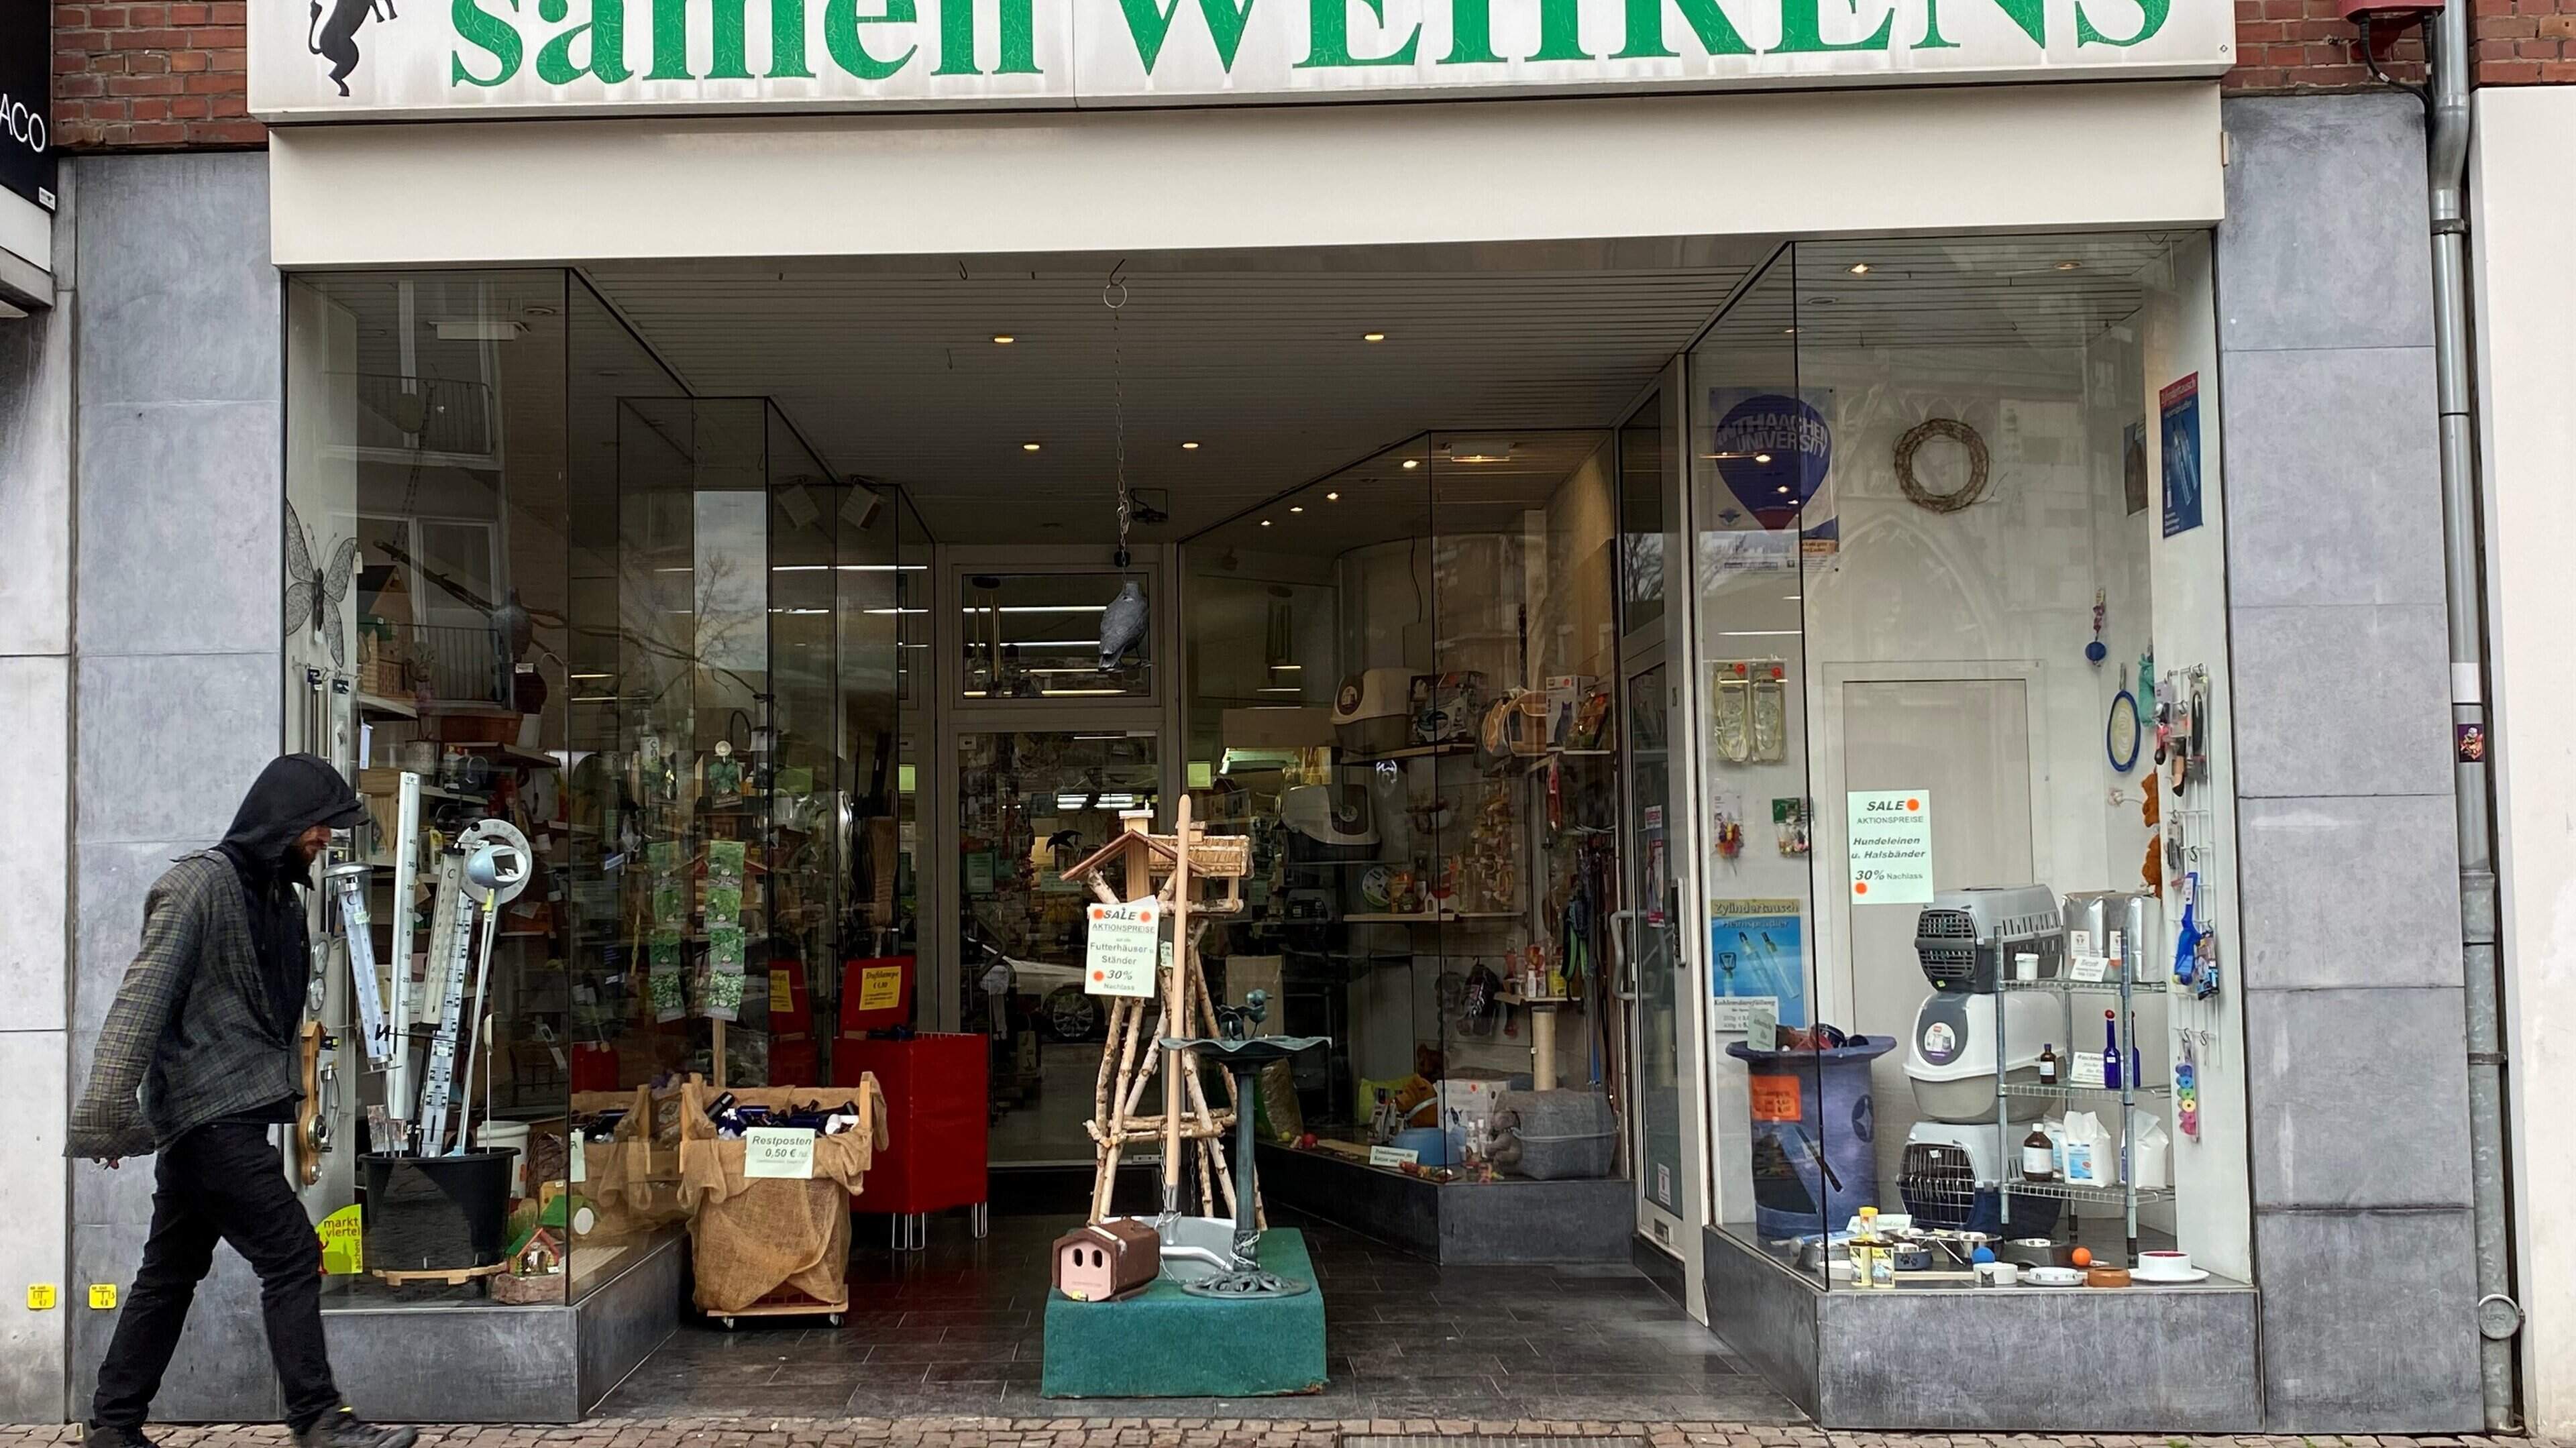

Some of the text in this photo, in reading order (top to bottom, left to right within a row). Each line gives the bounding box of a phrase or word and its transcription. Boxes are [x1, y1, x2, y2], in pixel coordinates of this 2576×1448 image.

[1736, 431, 1828, 458] UNIVERSITY
[1866, 801, 1904, 812] SALE
[1857, 816, 1923, 824] AKTIONSPREISE
[1853, 837, 1920, 846] Hundeleinen
[1864, 850, 1925, 859] Halsbänder
[1856, 870, 1884, 880] 30%
[1104, 909, 1137, 920] SALE
[1092, 924, 1155, 934] AKTIONSPREISE
[1090, 942, 1148, 953] Futterhäuser
[1102, 955, 1137, 964] Ständer
[1107, 970, 1132, 981] 30%
[752, 1135, 812, 1146] Restposten
[765, 1148, 787, 1158] 0,50
[324, 1217, 358, 1228] markt
[326, 1228, 360, 1237] viertel
